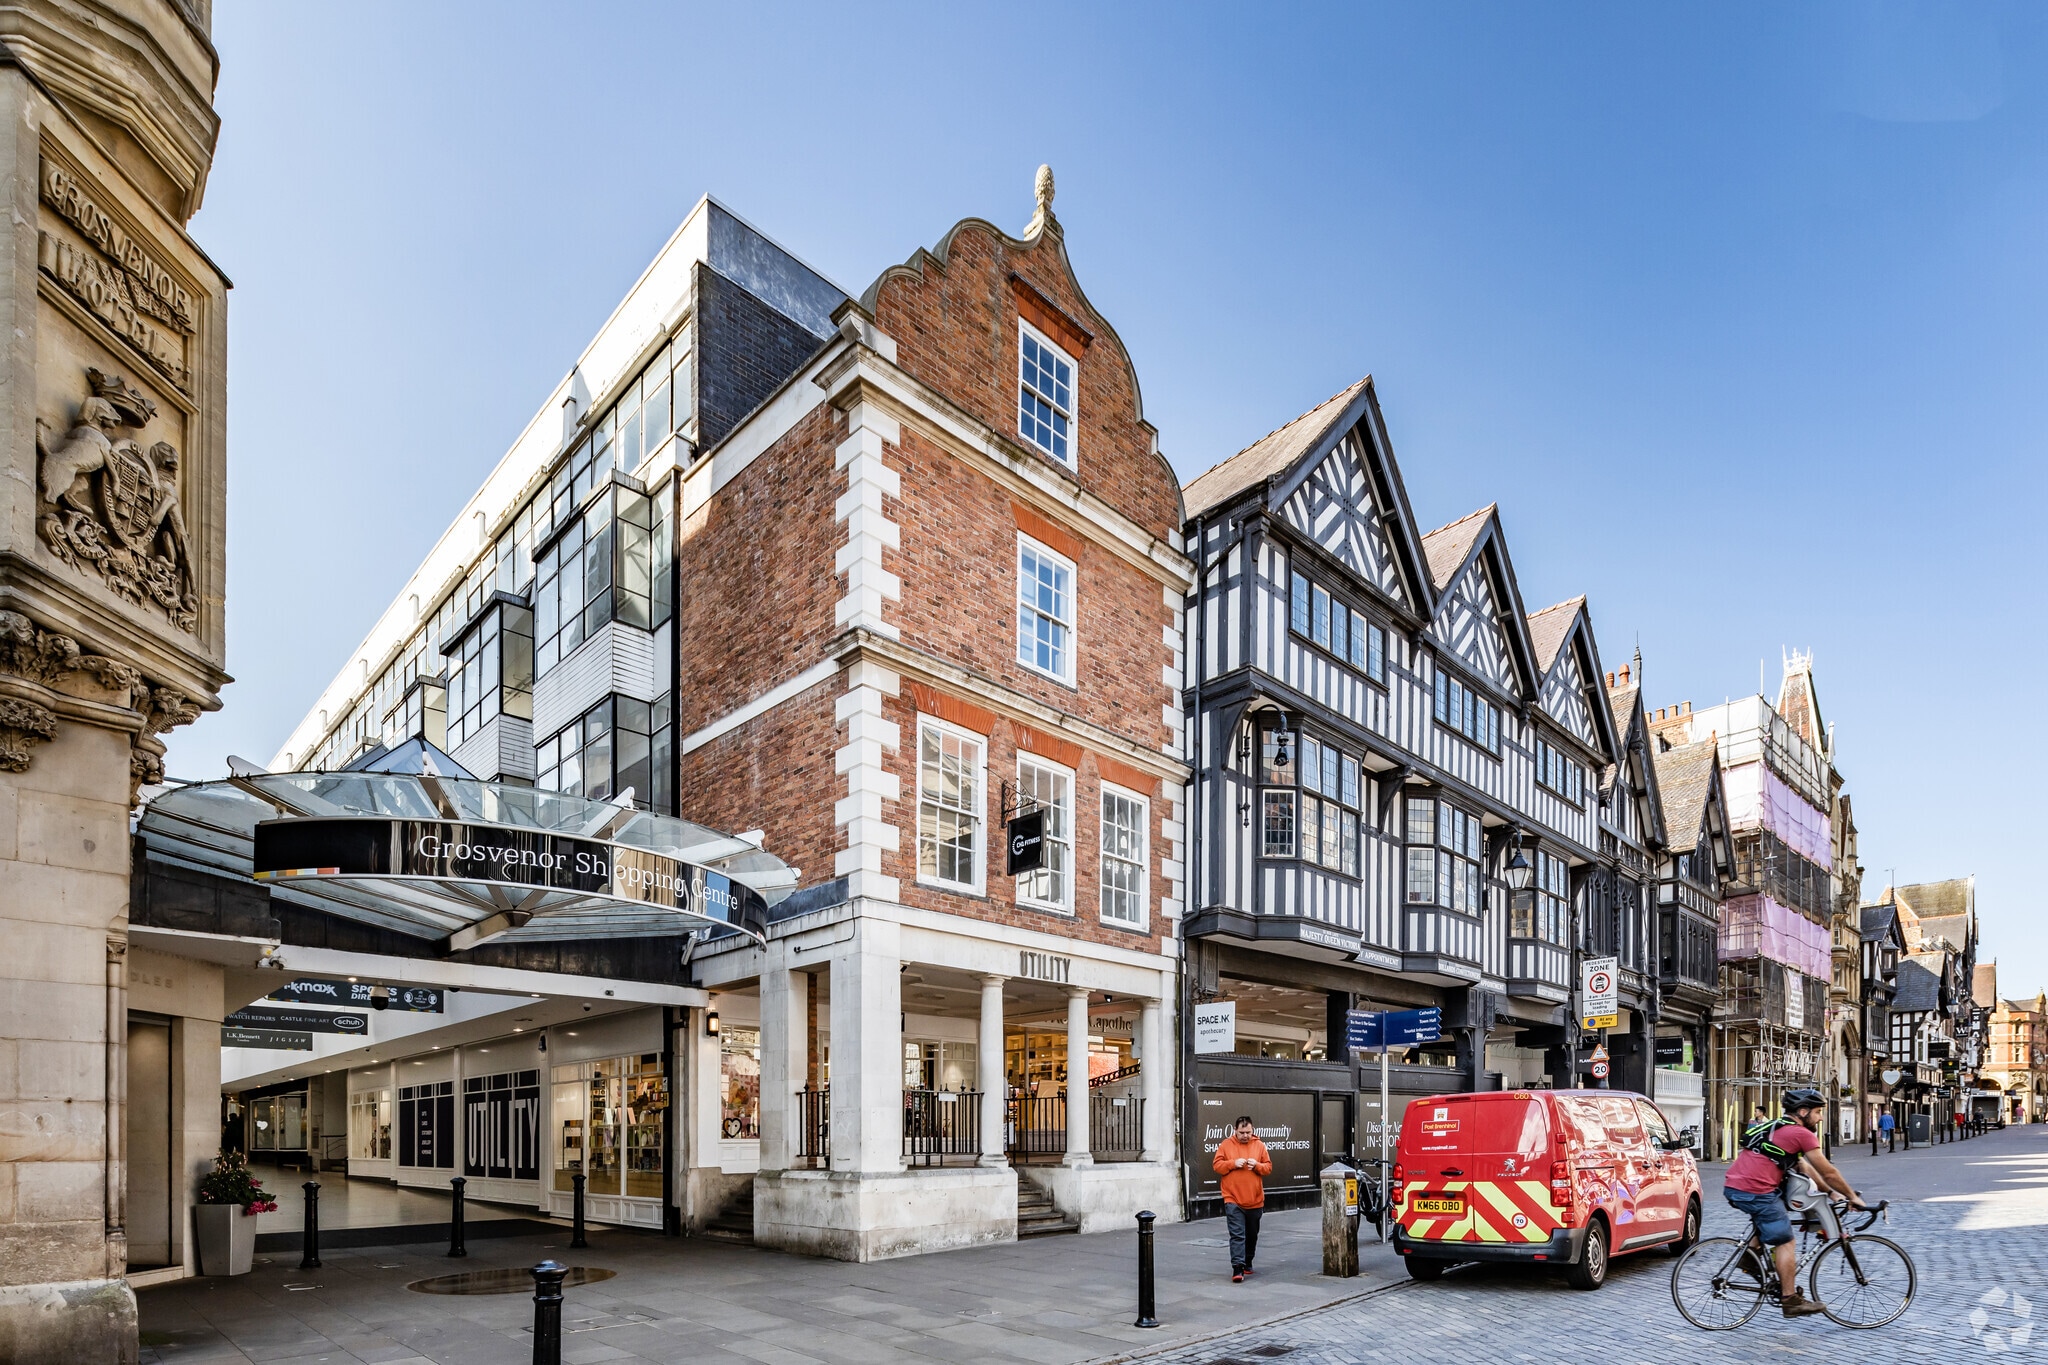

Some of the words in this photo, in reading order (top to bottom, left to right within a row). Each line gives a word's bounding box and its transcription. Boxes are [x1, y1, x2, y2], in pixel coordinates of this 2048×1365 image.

[48, 170, 192, 318] GROSVENOR
[67, 250, 168, 363] HOTEL
[418, 835, 566, 870] Grosvenor
[575, 851, 685, 898] Shopping
[691, 878, 739, 911] Centre
[1300, 927, 1324, 943] MAJESTY
[1324, 933, 1341, 946] QUEEN
[1341, 938, 1361, 952] VICTORIA
[1365, 950, 1400, 966] APPOINTMENT
[1020, 950, 1070, 983] UTILITY
[1590, 964, 1610, 973] ZONE
[337, 1018, 361, 1026] schuh
[1200, 1028, 1227, 1036] apothecary
[1595, 1065, 1606, 1074] 20
[1514, 1092, 1530, 1100] C60
[468, 1097, 539, 1169] UTILITY
[1203, 1123, 1223, 1142] Join
[1252, 1123, 1291, 1141] ommunity
[1286, 1140, 1310, 1150] OTHERS
[1417, 1200, 1440, 1210] KM66
[1441, 1201, 1460, 1211] OBO
